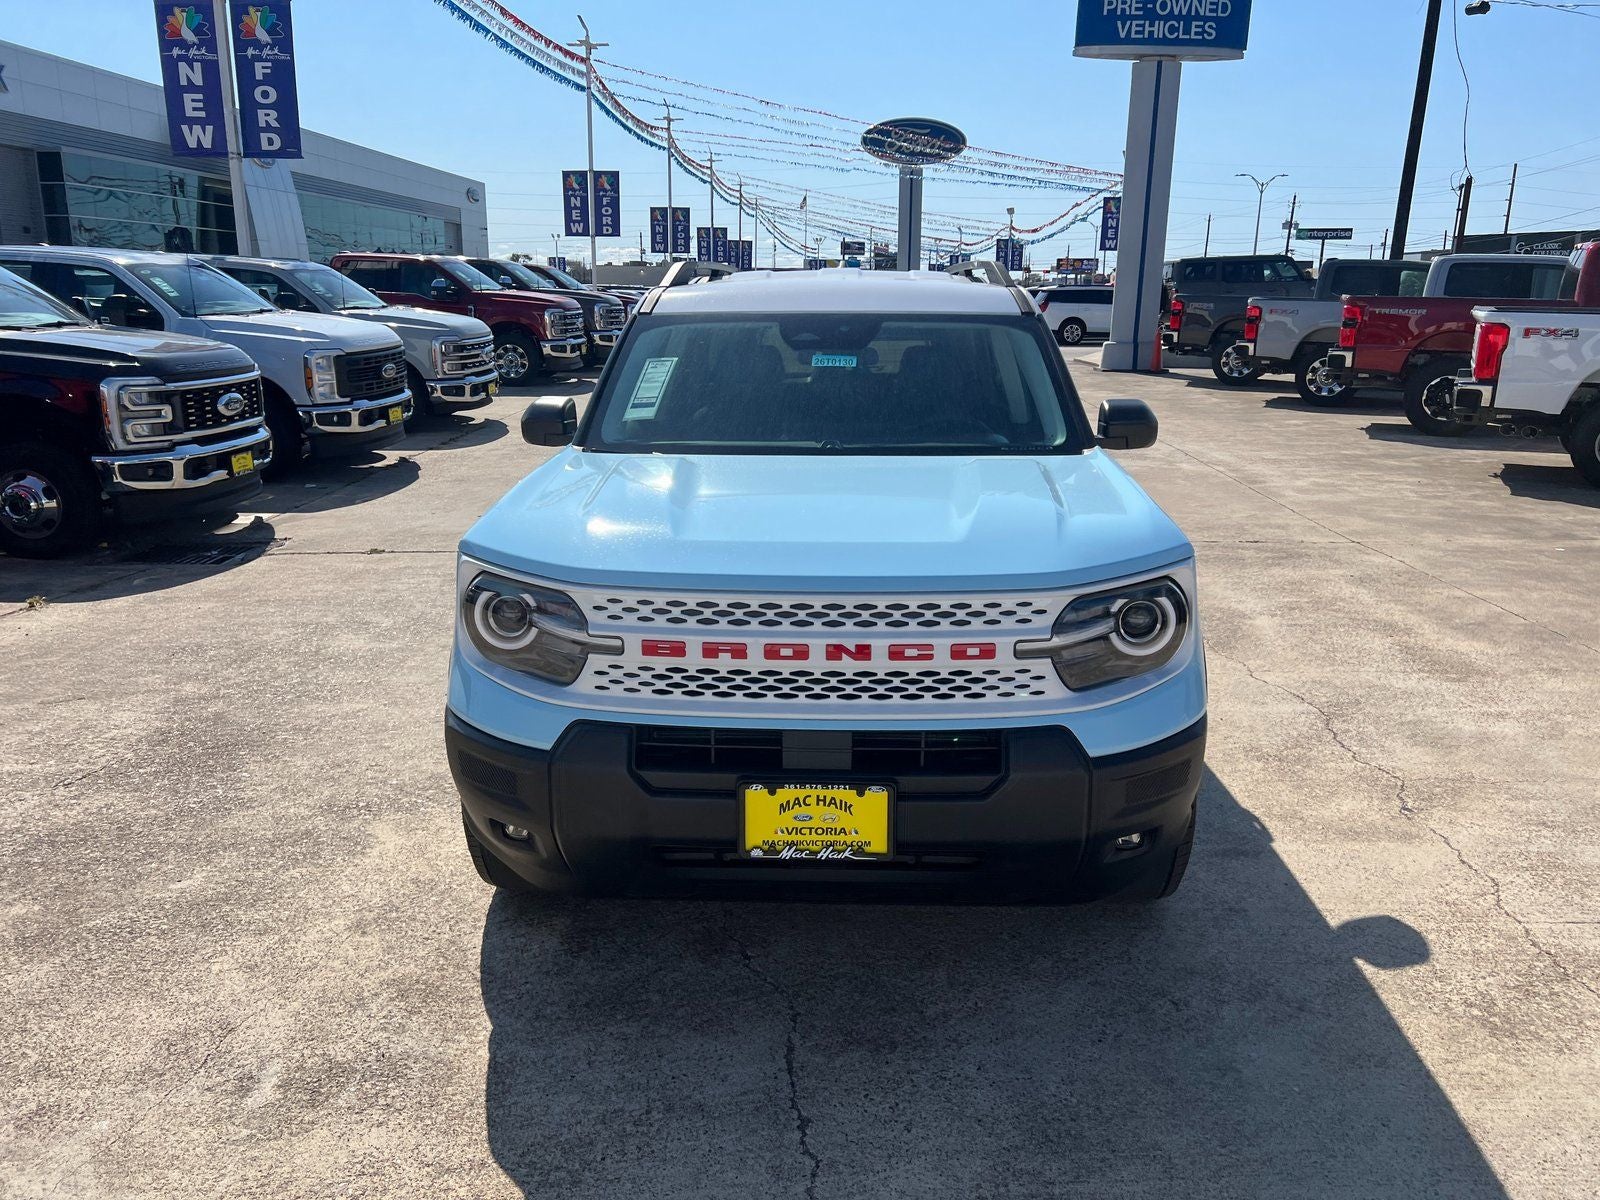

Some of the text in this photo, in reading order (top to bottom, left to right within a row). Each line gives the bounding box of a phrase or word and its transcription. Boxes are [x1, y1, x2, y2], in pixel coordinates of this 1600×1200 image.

[1117, 20, 1217, 40] VEHICLES
[178, 61, 214, 149] NEW
[253, 61, 282, 151] FORD
[570, 196, 584, 233] NEW
[601, 197, 612, 234] FORD
[655, 225, 665, 251] NEW
[677, 226, 685, 252] FORD
[1105, 218, 1118, 249] NEW
[1301, 230, 1352, 238] enterprise
[1522, 327, 1580, 339] FX4
[814, 357, 853, 366] 26T0130
[641, 639, 996, 661] BRONCO
[778, 794, 854, 817] MAC HAIK
[784, 826, 848, 836] VICTORIA
[762, 839, 872, 848] MACHAIKVICTORIA.COM
[777, 845, 855, 860] Mac Haik
